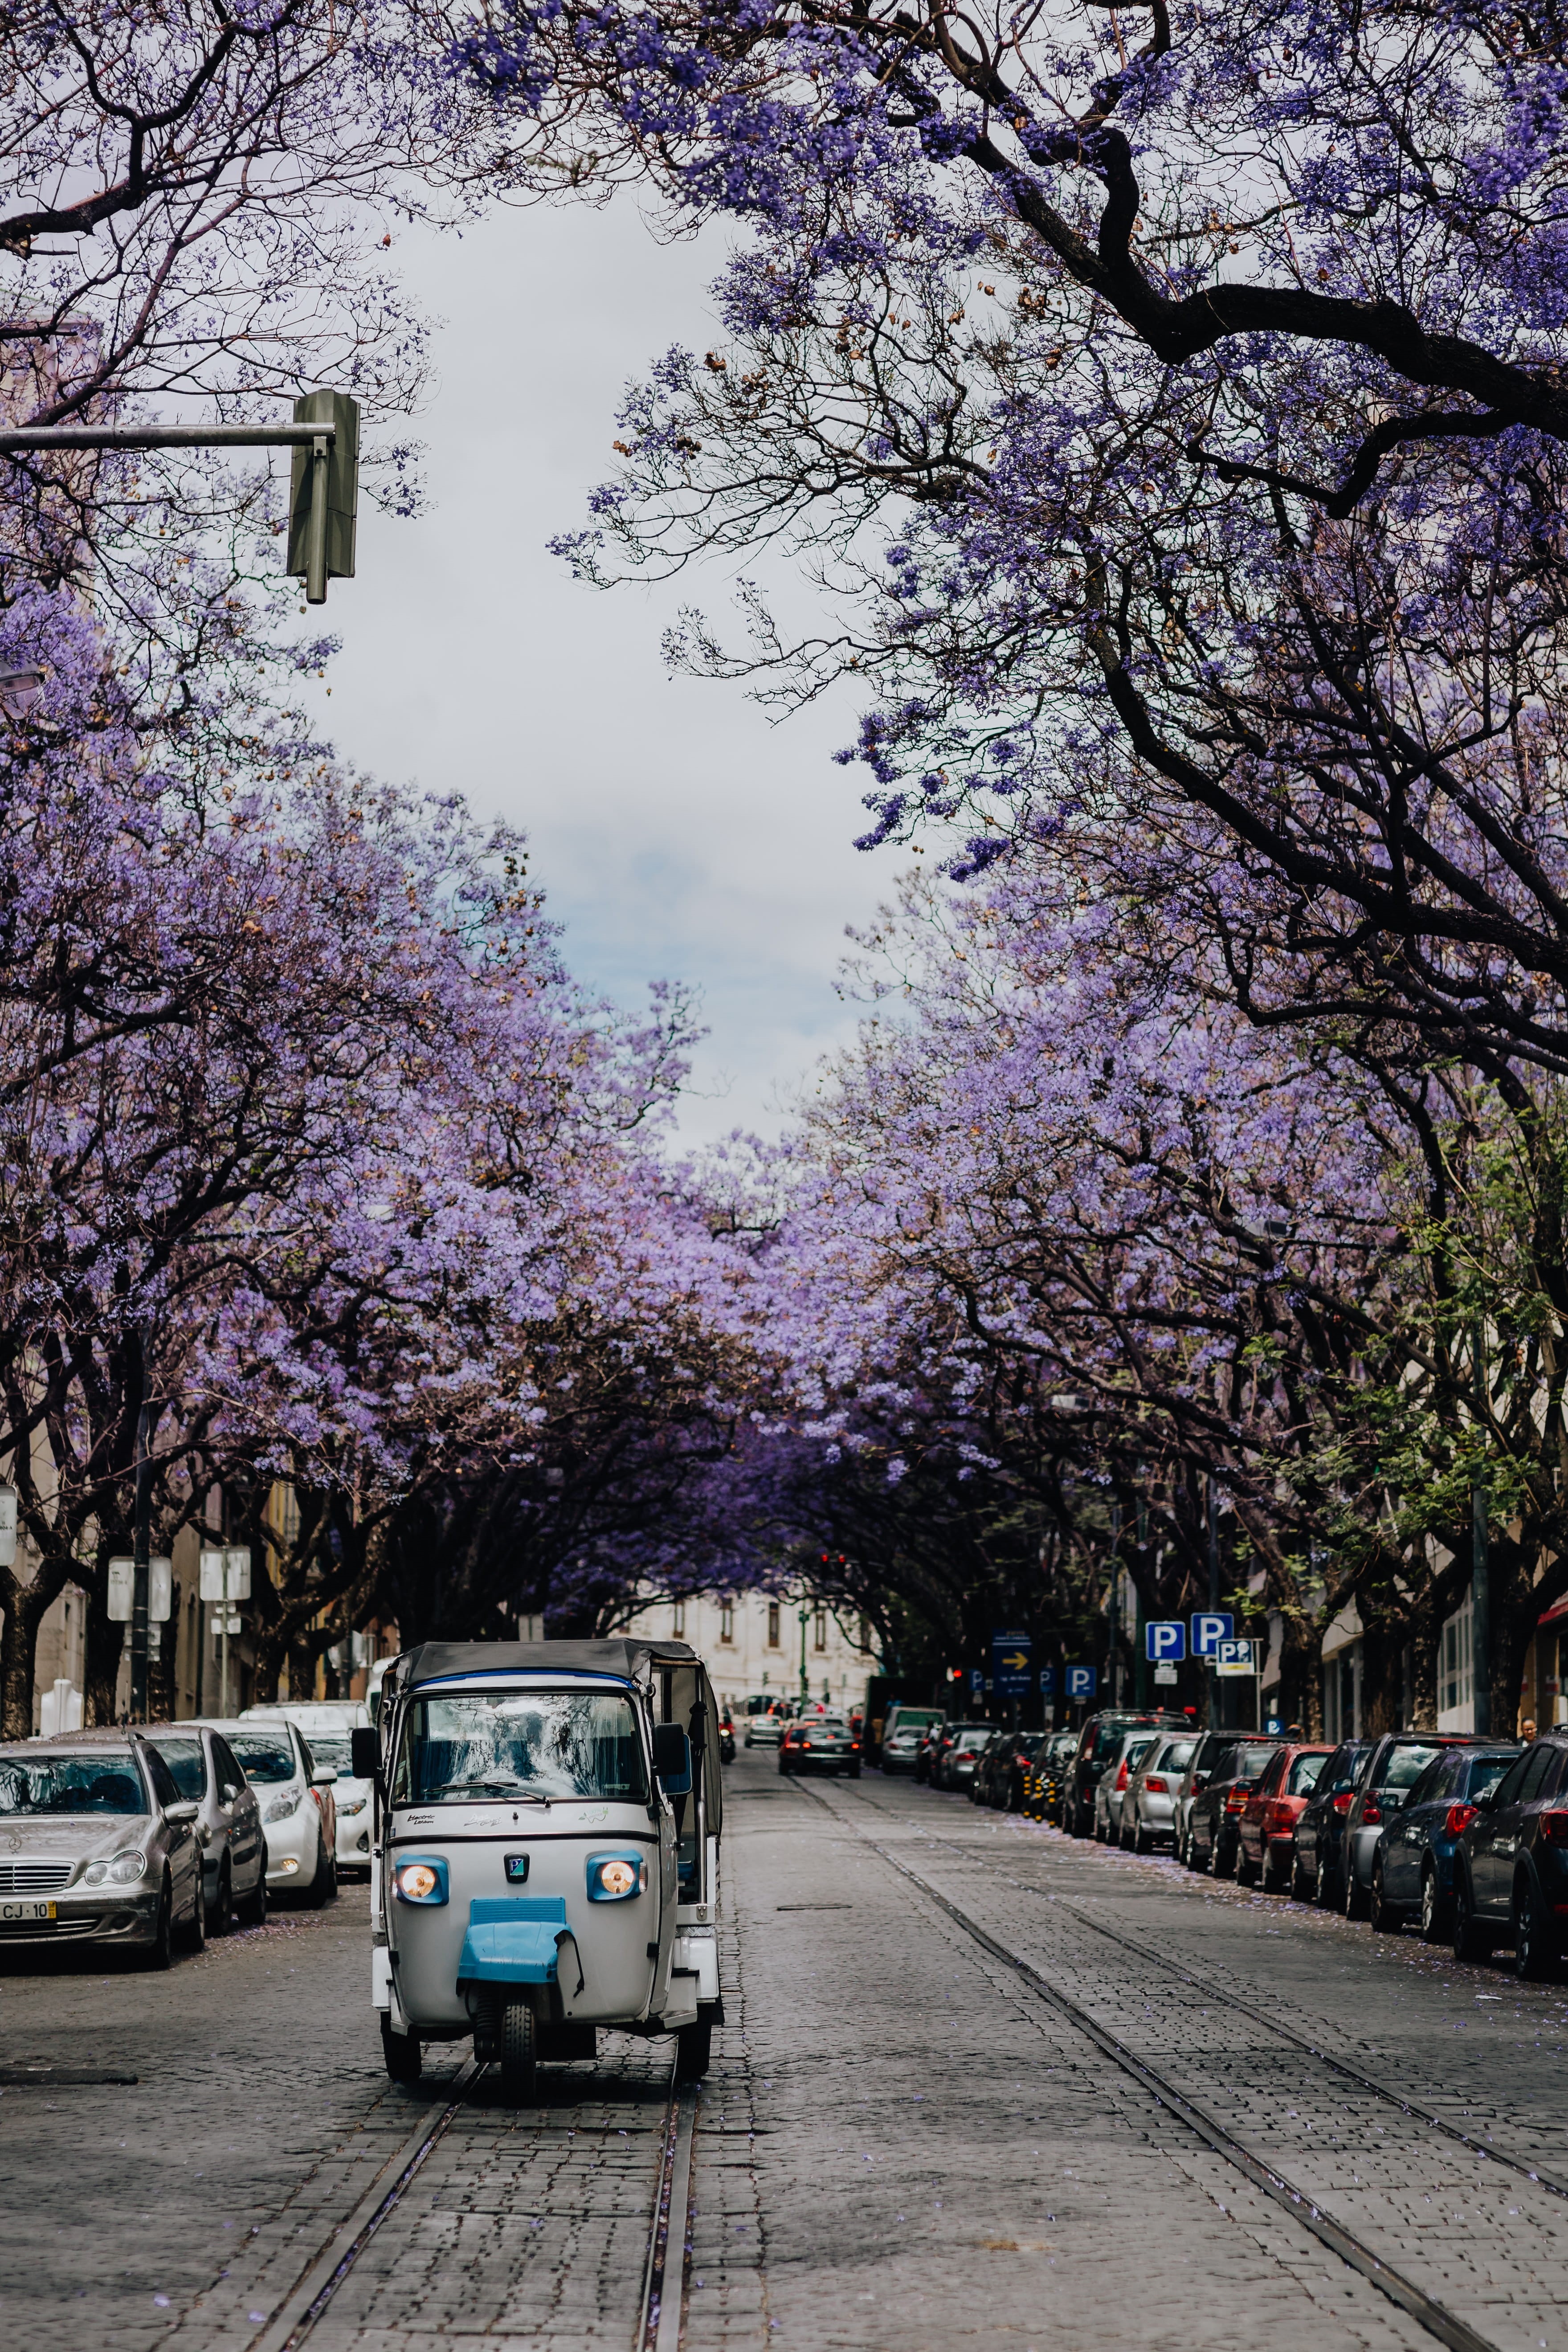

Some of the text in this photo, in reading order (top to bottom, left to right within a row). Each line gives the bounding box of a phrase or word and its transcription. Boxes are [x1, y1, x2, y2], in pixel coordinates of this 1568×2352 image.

[1155, 1626, 1177, 1657] P
[1200, 1617, 1225, 1652] P
[1221, 1643, 1236, 1662] P
[973, 1671, 983, 1688] P
[1040, 1671, 1050, 1686] P
[1072, 1670, 1090, 1694] P
[33, 1903, 47, 1918] 10
